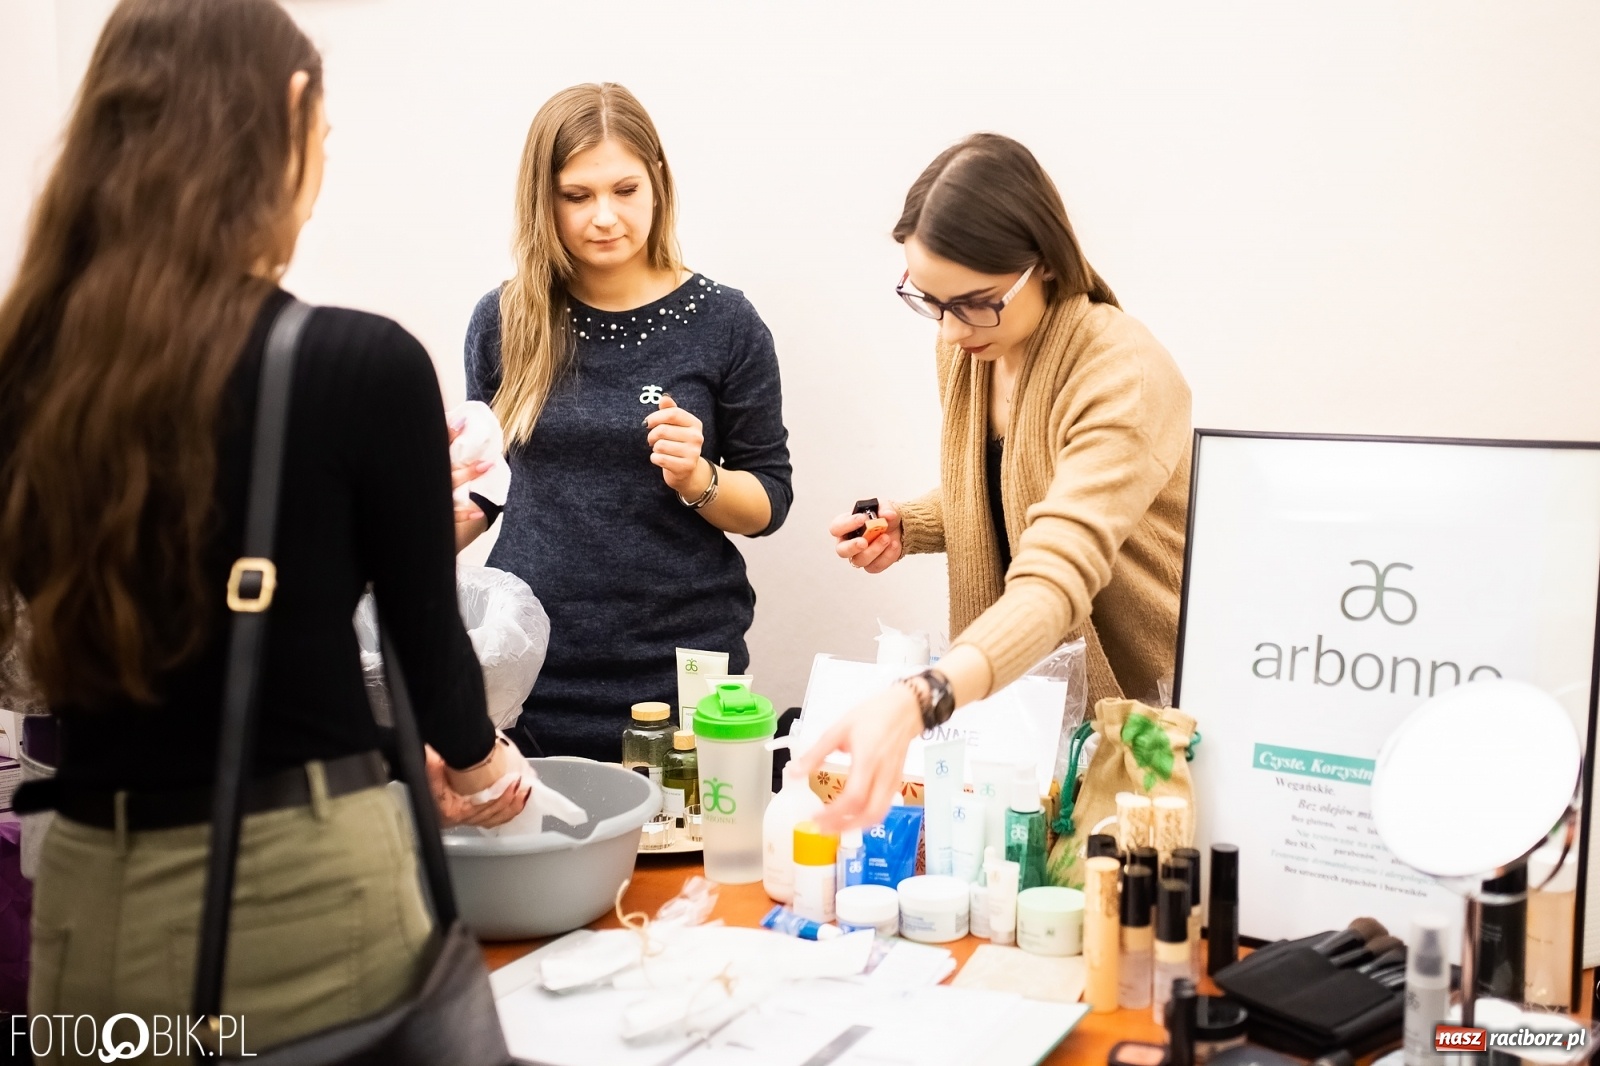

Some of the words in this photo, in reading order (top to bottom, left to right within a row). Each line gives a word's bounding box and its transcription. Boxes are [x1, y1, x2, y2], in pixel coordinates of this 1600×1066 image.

[921, 725, 980, 747] ONNE
[1259, 751, 1306, 770] Czyste.
[1311, 758, 1373, 780] Korzystn
[1298, 799, 1316, 812] Bez
